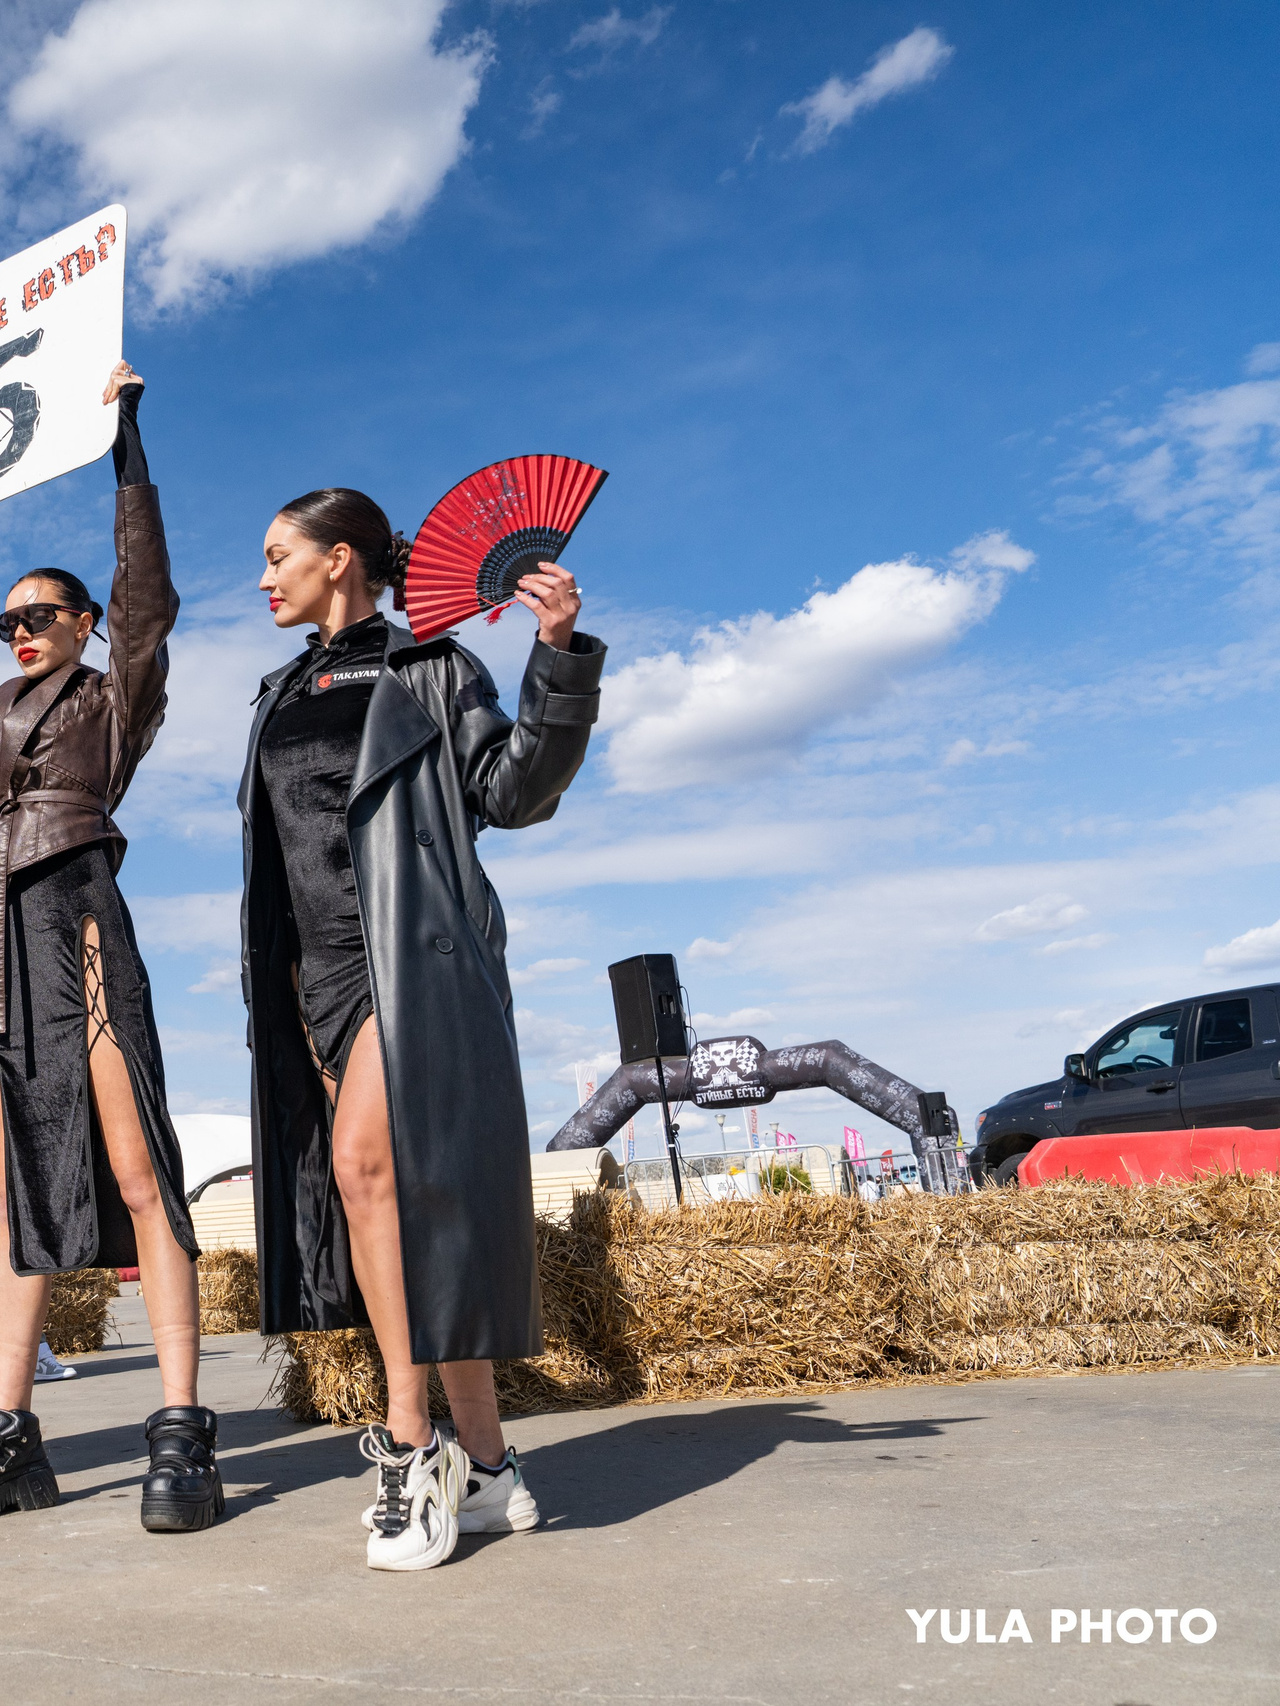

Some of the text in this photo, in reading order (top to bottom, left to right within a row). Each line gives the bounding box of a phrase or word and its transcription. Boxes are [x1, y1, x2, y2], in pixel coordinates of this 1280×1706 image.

[23, 223, 117, 312] ЕСТЬ?
[333, 670, 379, 681] TAKAYAM
[695, 1085, 766, 1105] БУЙНЫЕ ЕСТЬ?
